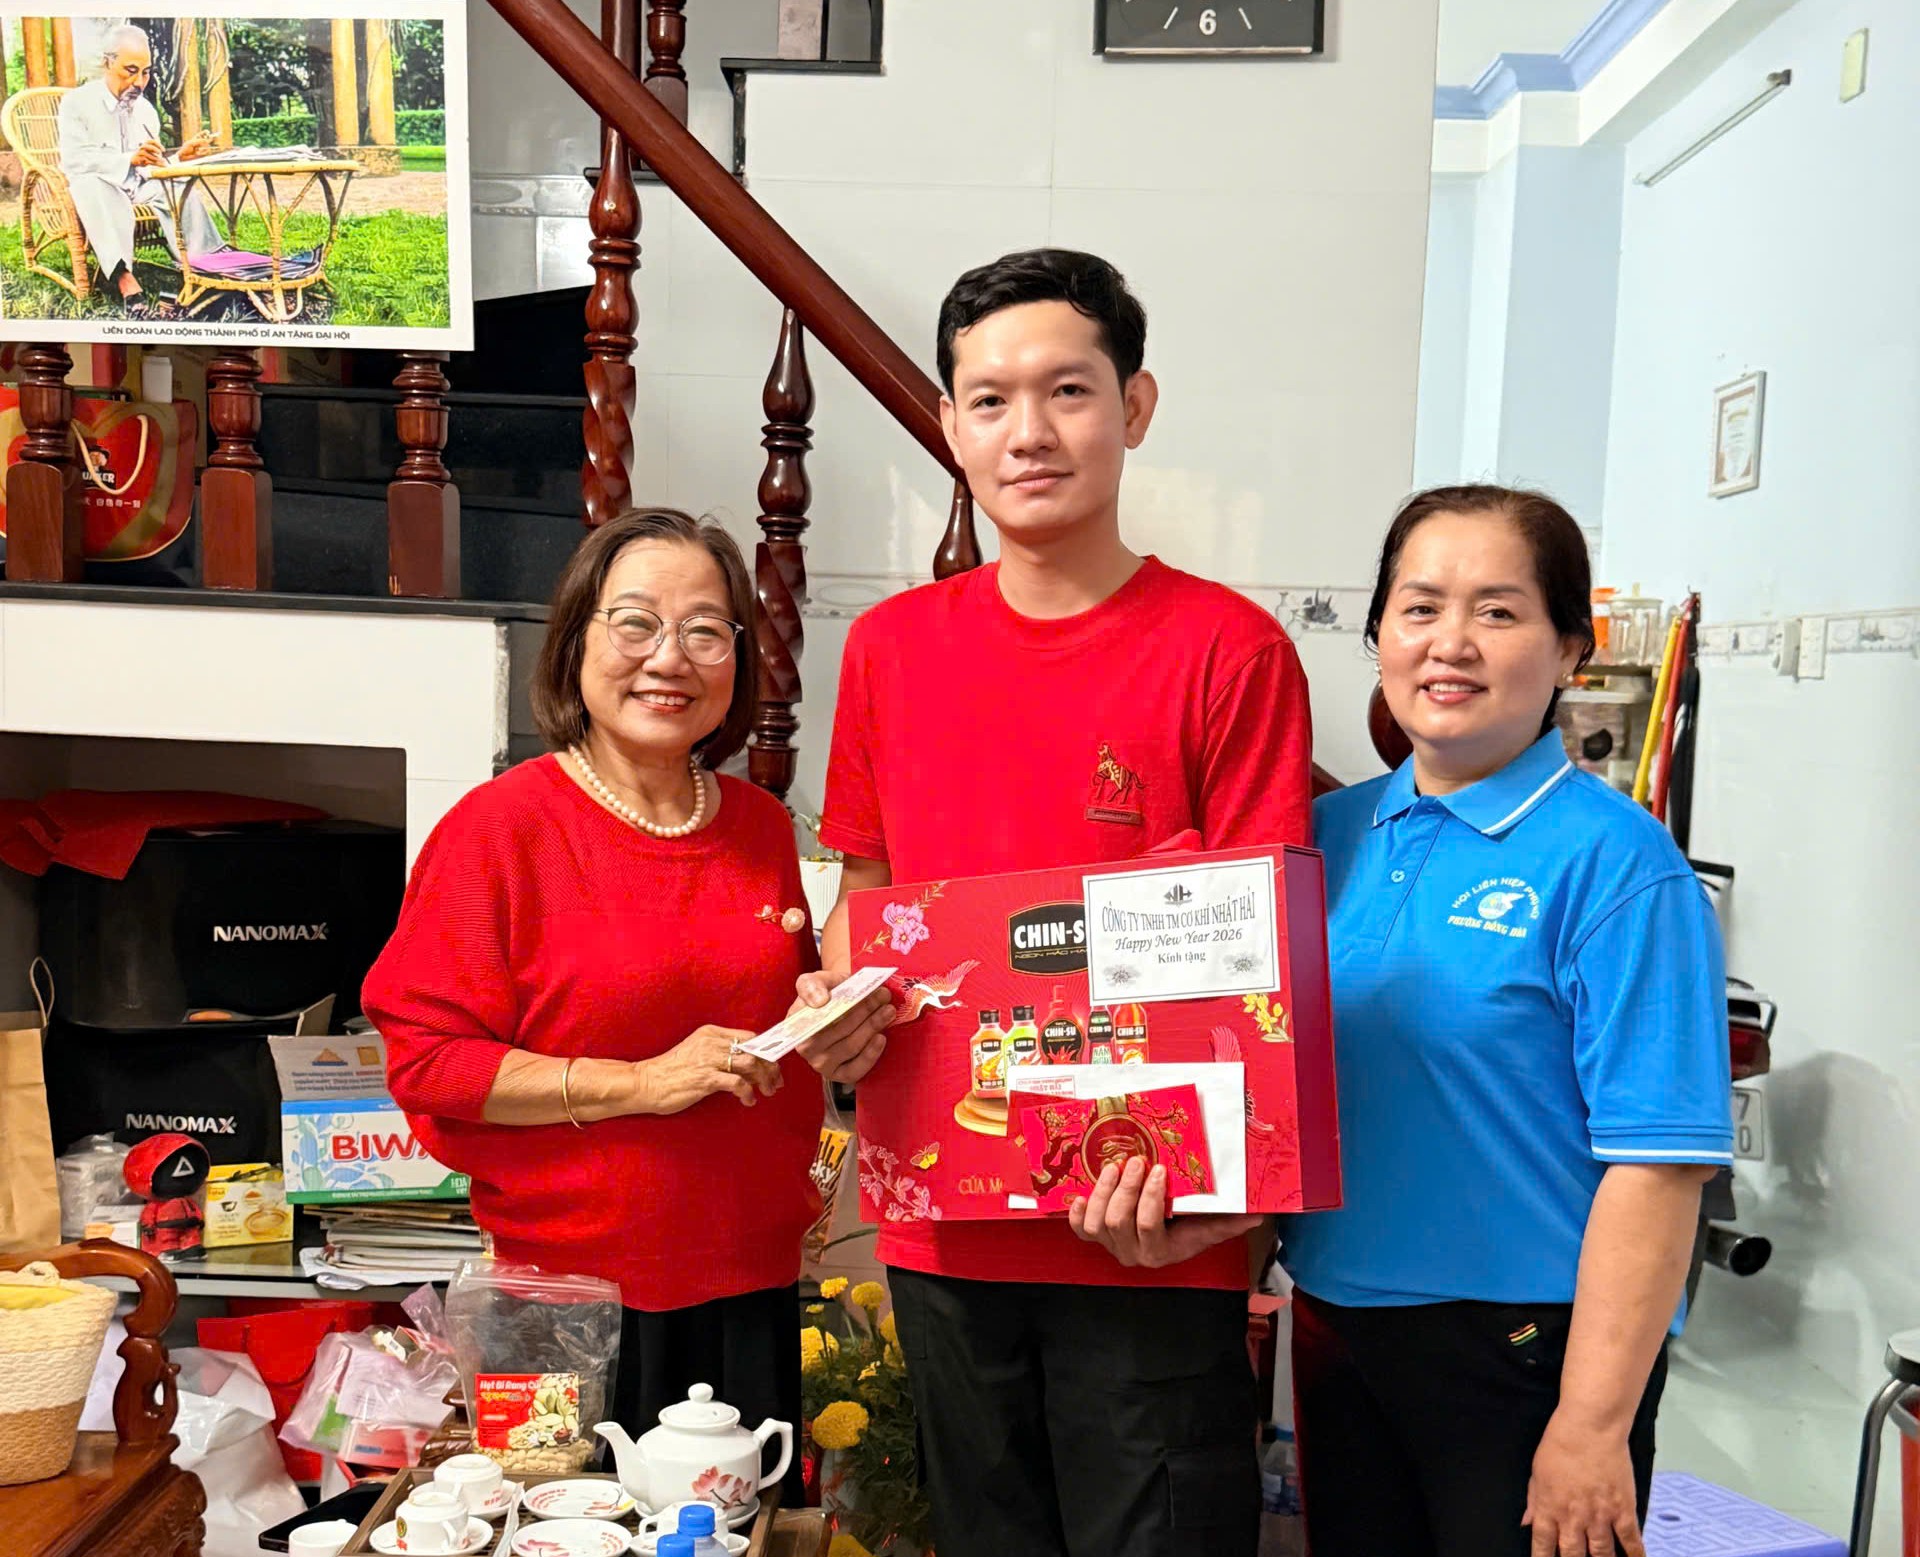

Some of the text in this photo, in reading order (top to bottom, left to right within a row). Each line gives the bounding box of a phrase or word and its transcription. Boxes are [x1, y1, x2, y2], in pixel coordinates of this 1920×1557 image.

[1200, 9, 1216, 35] 6
[102, 325, 123, 334] LIÊN
[154, 327, 173, 335] LAO
[204, 327, 236, 337] THÀNH
[238, 327, 258, 337] PHỐ
[272, 330, 286, 338] AN
[334, 330, 351, 341] HỘI
[1102, 886, 1256, 932] CÔNG TY TNHH TM CƠ KHÍ NHẬT HẢI
[213, 922, 328, 942] NANOMAX
[1014, 919, 1085, 949] CHIN-S
[1115, 928, 1243, 953] Happy New Year 2026
[1158, 951, 1206, 964] Kính tặng
[1044, 1025, 1077, 1038] CHIN-SU
[126, 1114, 236, 1134] NANOMAX
[331, 1133, 430, 1161] BIW
[809, 1159, 837, 1184] cky
